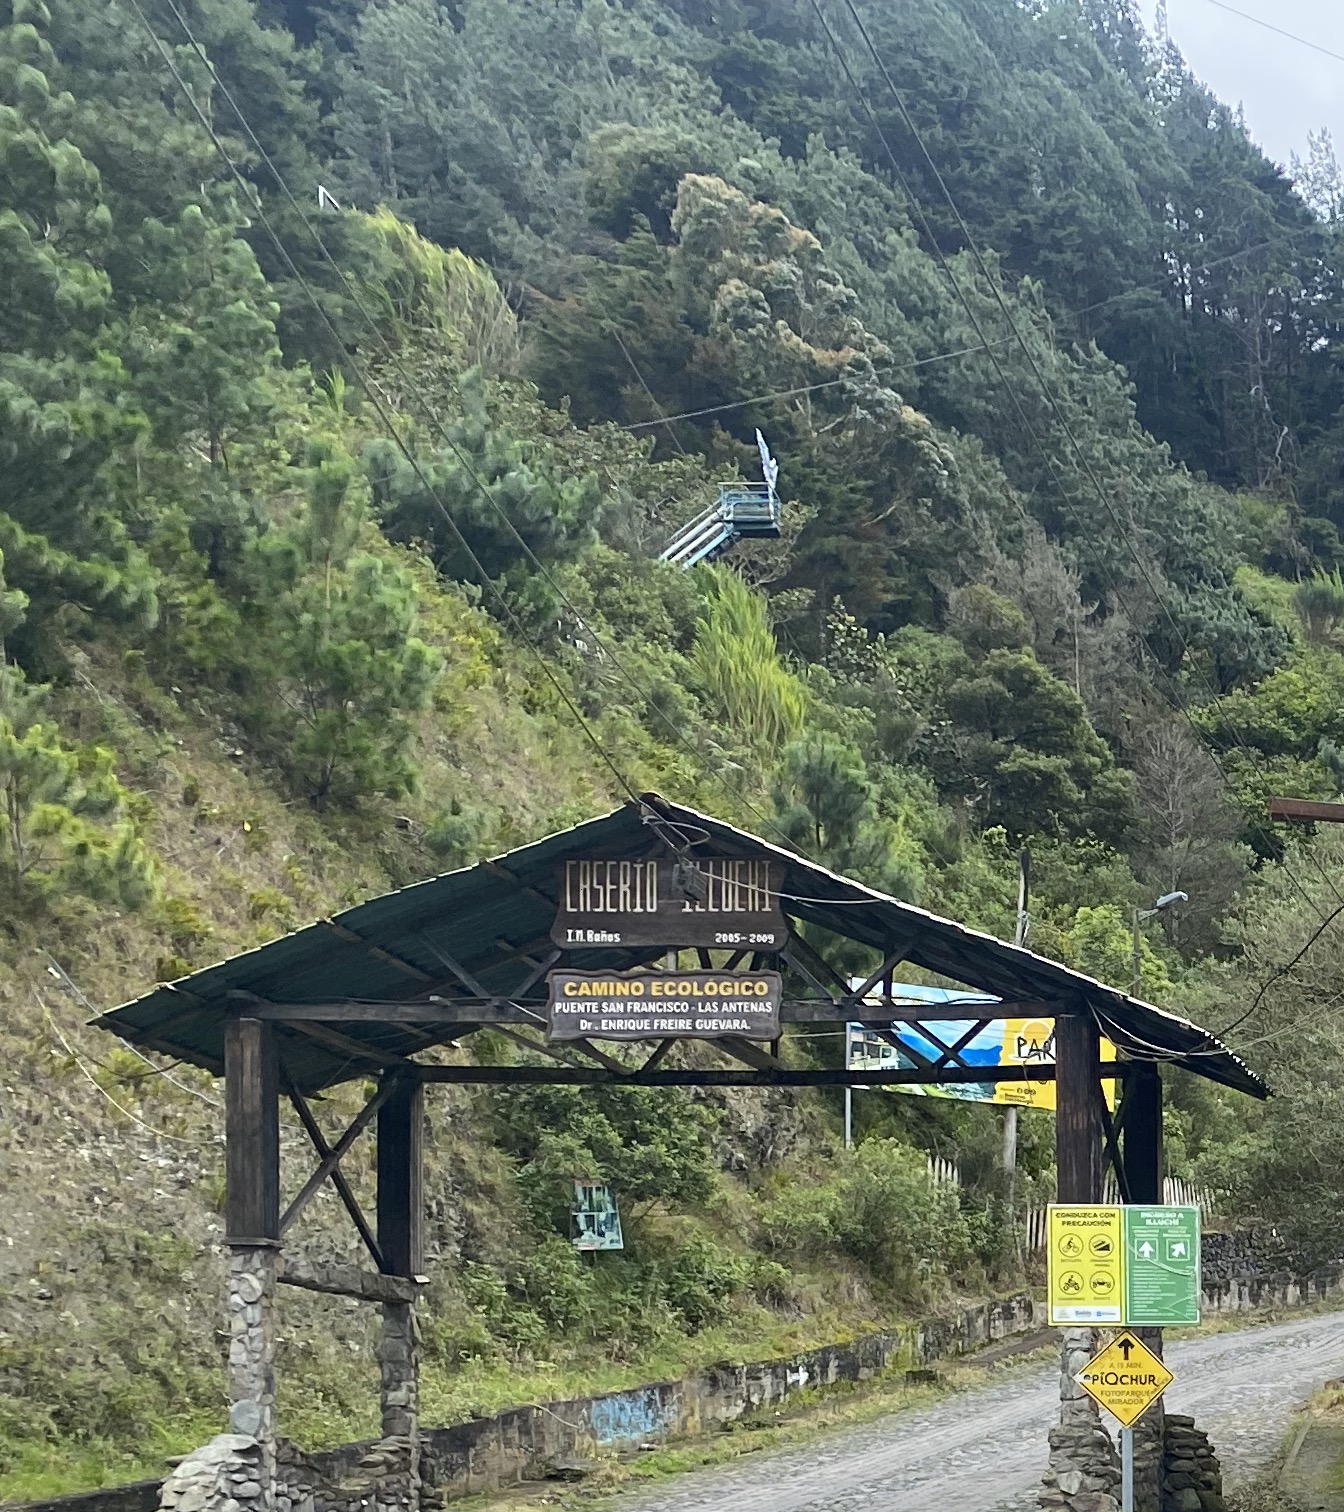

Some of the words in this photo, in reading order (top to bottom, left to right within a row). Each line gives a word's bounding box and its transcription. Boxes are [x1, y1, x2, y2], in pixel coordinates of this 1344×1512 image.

[681, 860, 772, 913] LLUCHI
[564, 981, 645, 997] CAMINO
[651, 978, 769, 997] ECOLÓGICO
[555, 1001, 599, 1014] PUENTE
[601, 1001, 624, 1014] SAN
[627, 1001, 690, 1014] FRANCISCO
[698, 1001, 719, 1014] LAS
[721, 1001, 773, 1014] ANTENAS
[601, 1018, 650, 1032] ENRIQUE
[653, 1018, 692, 1031] FREIRE
